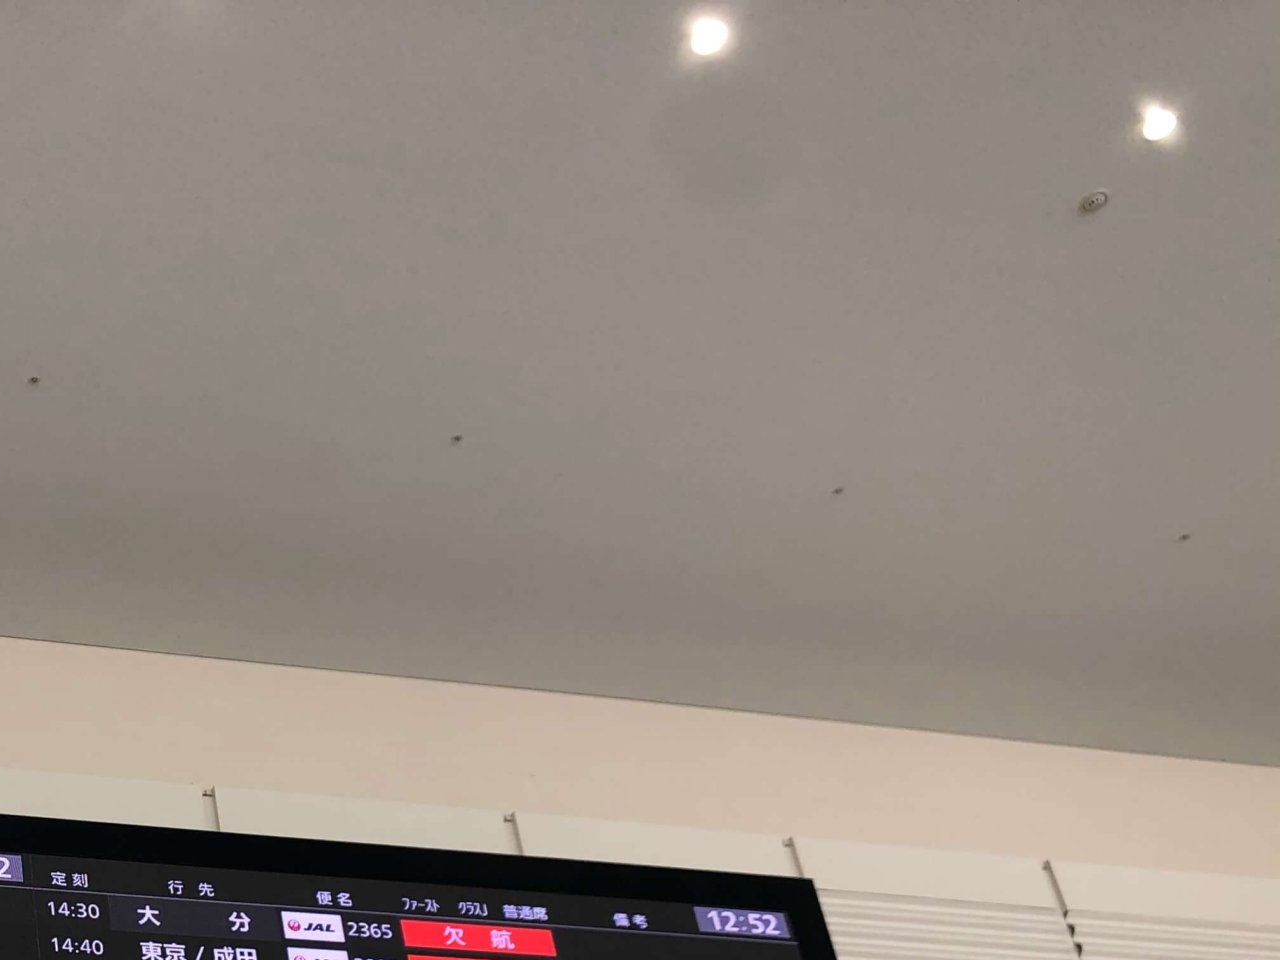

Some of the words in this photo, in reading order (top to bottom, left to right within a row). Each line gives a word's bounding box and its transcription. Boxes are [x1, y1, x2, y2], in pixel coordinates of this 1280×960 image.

[48, 902, 99, 918] 14:30
[303, 922, 336, 933] JAL
[347, 922, 392, 938] 2365
[708, 911, 780, 934] 12:52
[52, 937, 103, 955] 14:40
